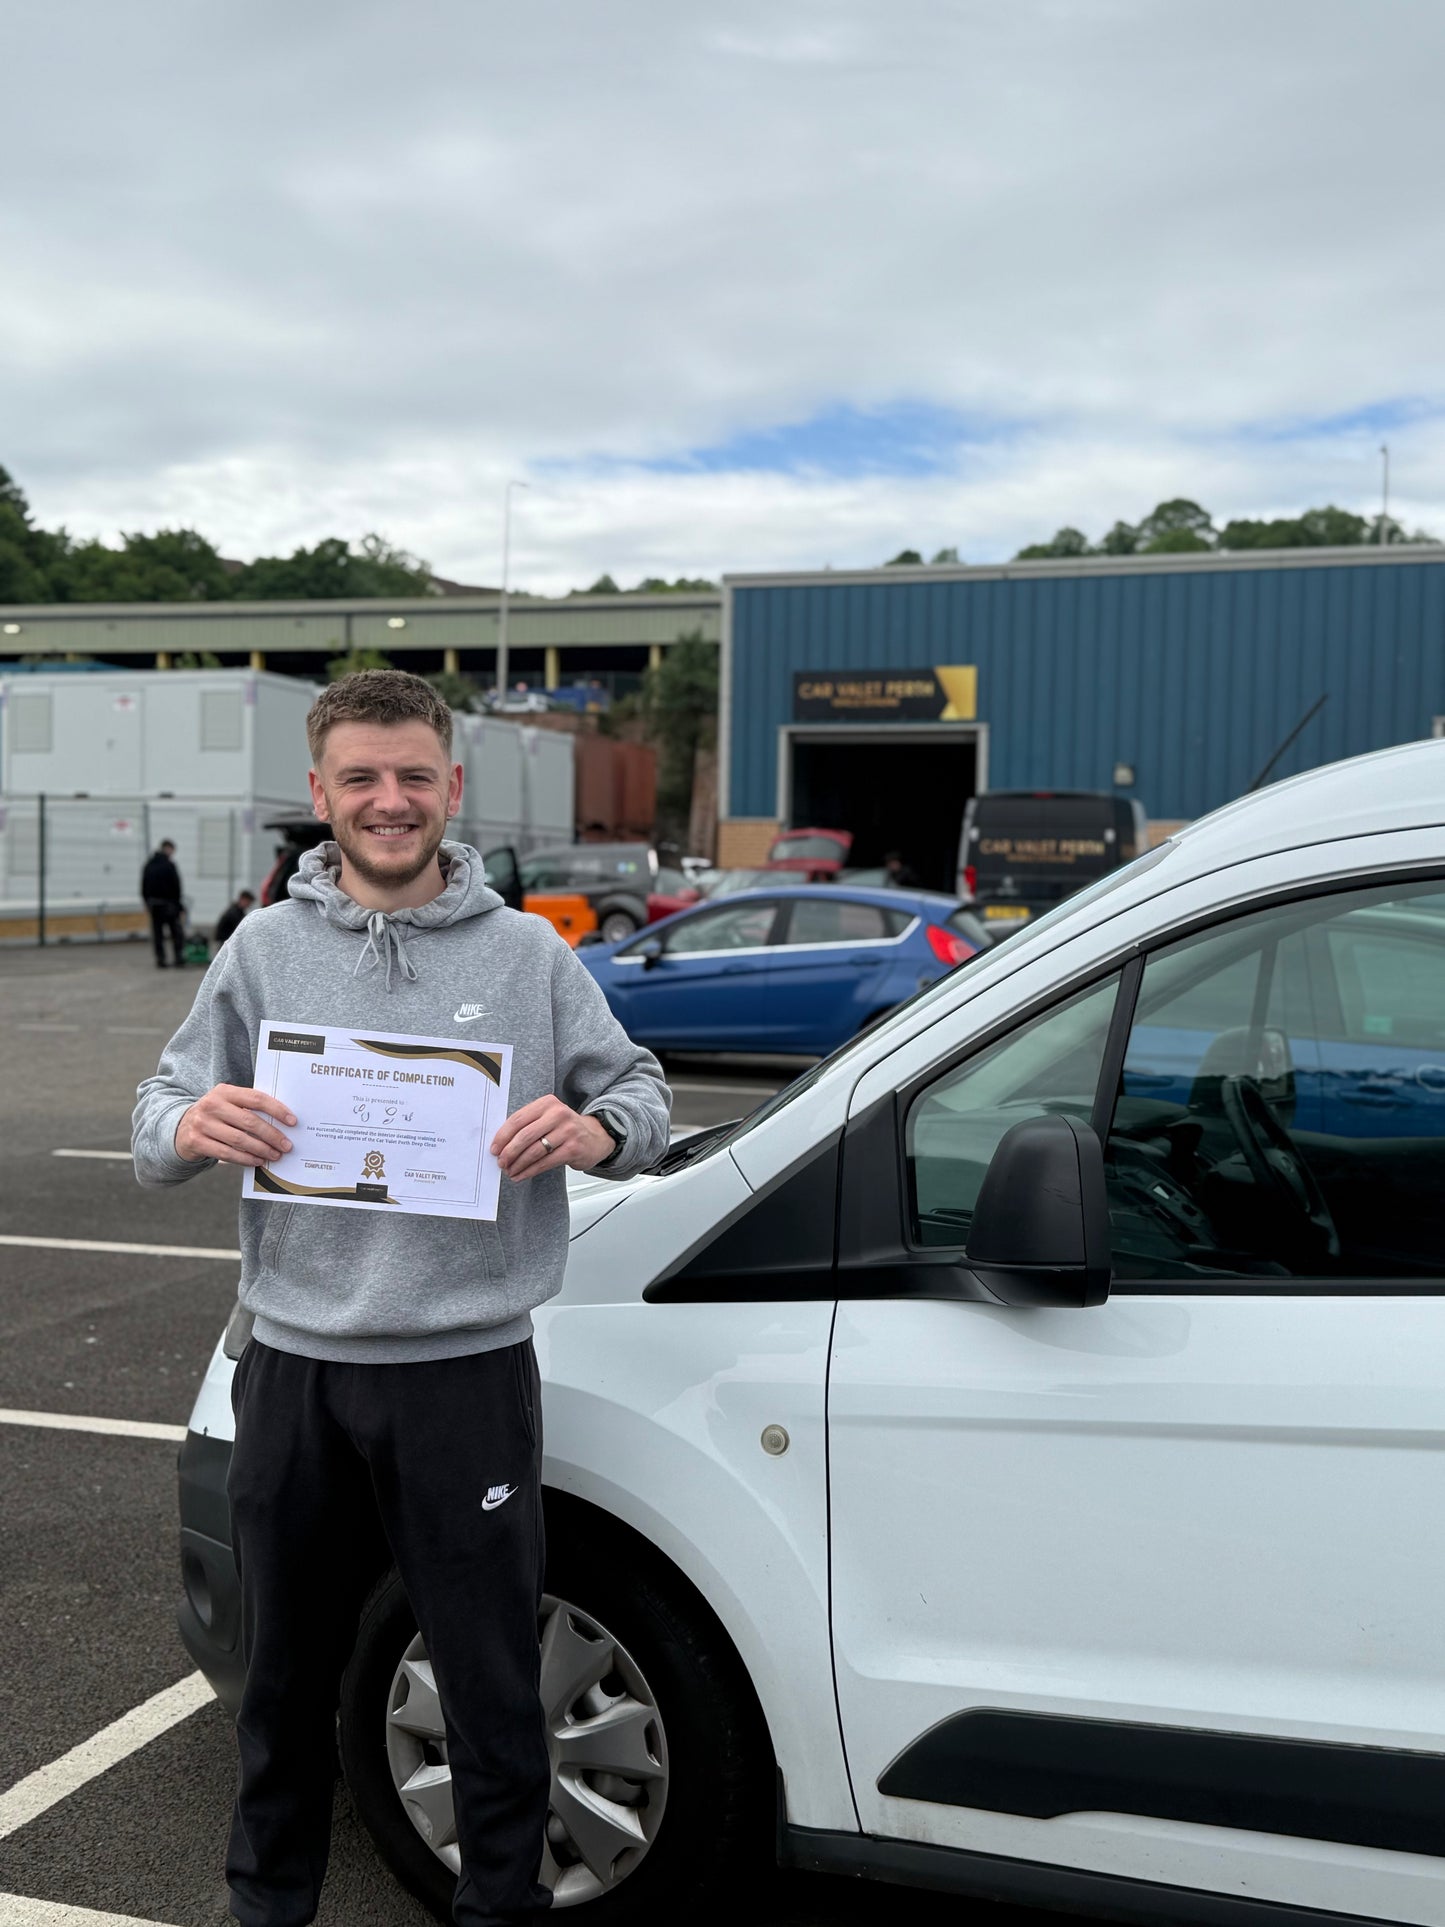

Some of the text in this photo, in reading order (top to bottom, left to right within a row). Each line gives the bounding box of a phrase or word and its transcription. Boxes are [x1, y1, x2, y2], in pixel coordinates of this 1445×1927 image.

[798, 680, 935, 699] CAR VALET PERTH
[979, 838, 1012, 855] CAR
[1015, 838, 1057, 854] VALET
[1060, 839, 1105, 855] PERTH
[459, 1003, 483, 1016] NIKE
[311, 1062, 454, 1087] CERTIFICATE OF COMPLETION
[305, 1162, 332, 1170] COMPLETED
[487, 1483, 510, 1501] NIKE
